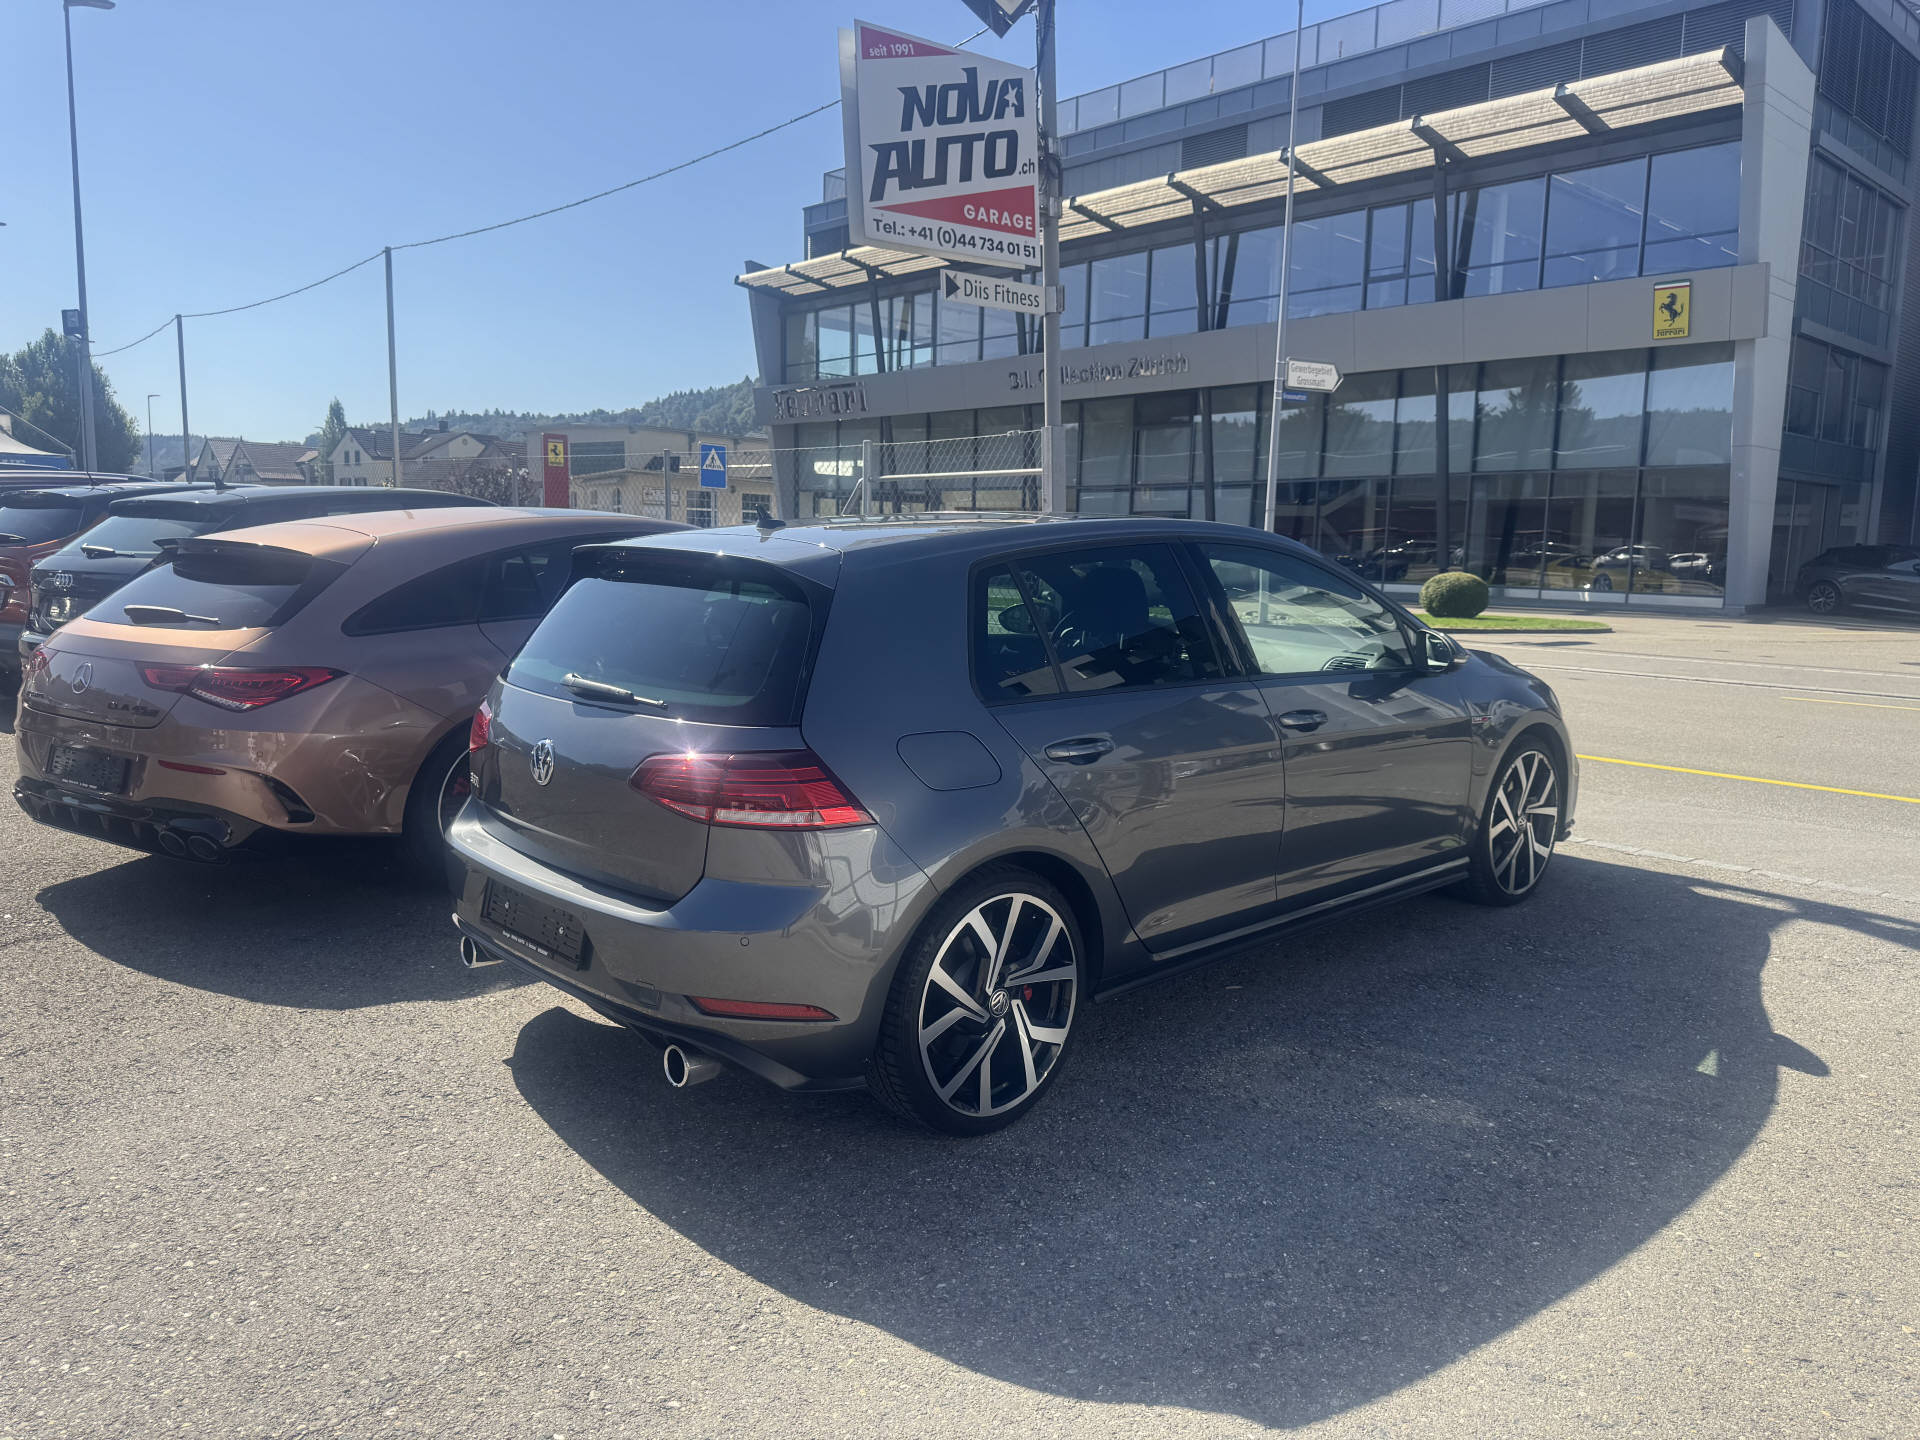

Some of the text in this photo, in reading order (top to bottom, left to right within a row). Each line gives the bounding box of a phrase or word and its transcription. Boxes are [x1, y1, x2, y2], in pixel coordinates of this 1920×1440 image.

[869, 43, 914, 57] seit 1991
[897, 67, 1025, 132] NOVA
[868, 130, 1018, 202] AUTO
[964, 204, 1033, 231] GARAGE
[873, 218, 905, 236] Tel.:
[908, 225, 934, 241] +41
[979, 236, 1005, 252] 734
[1007, 242, 1020, 255] 01
[1023, 244, 1036, 259] 51
[964, 279, 1040, 308] Diis Fitness
